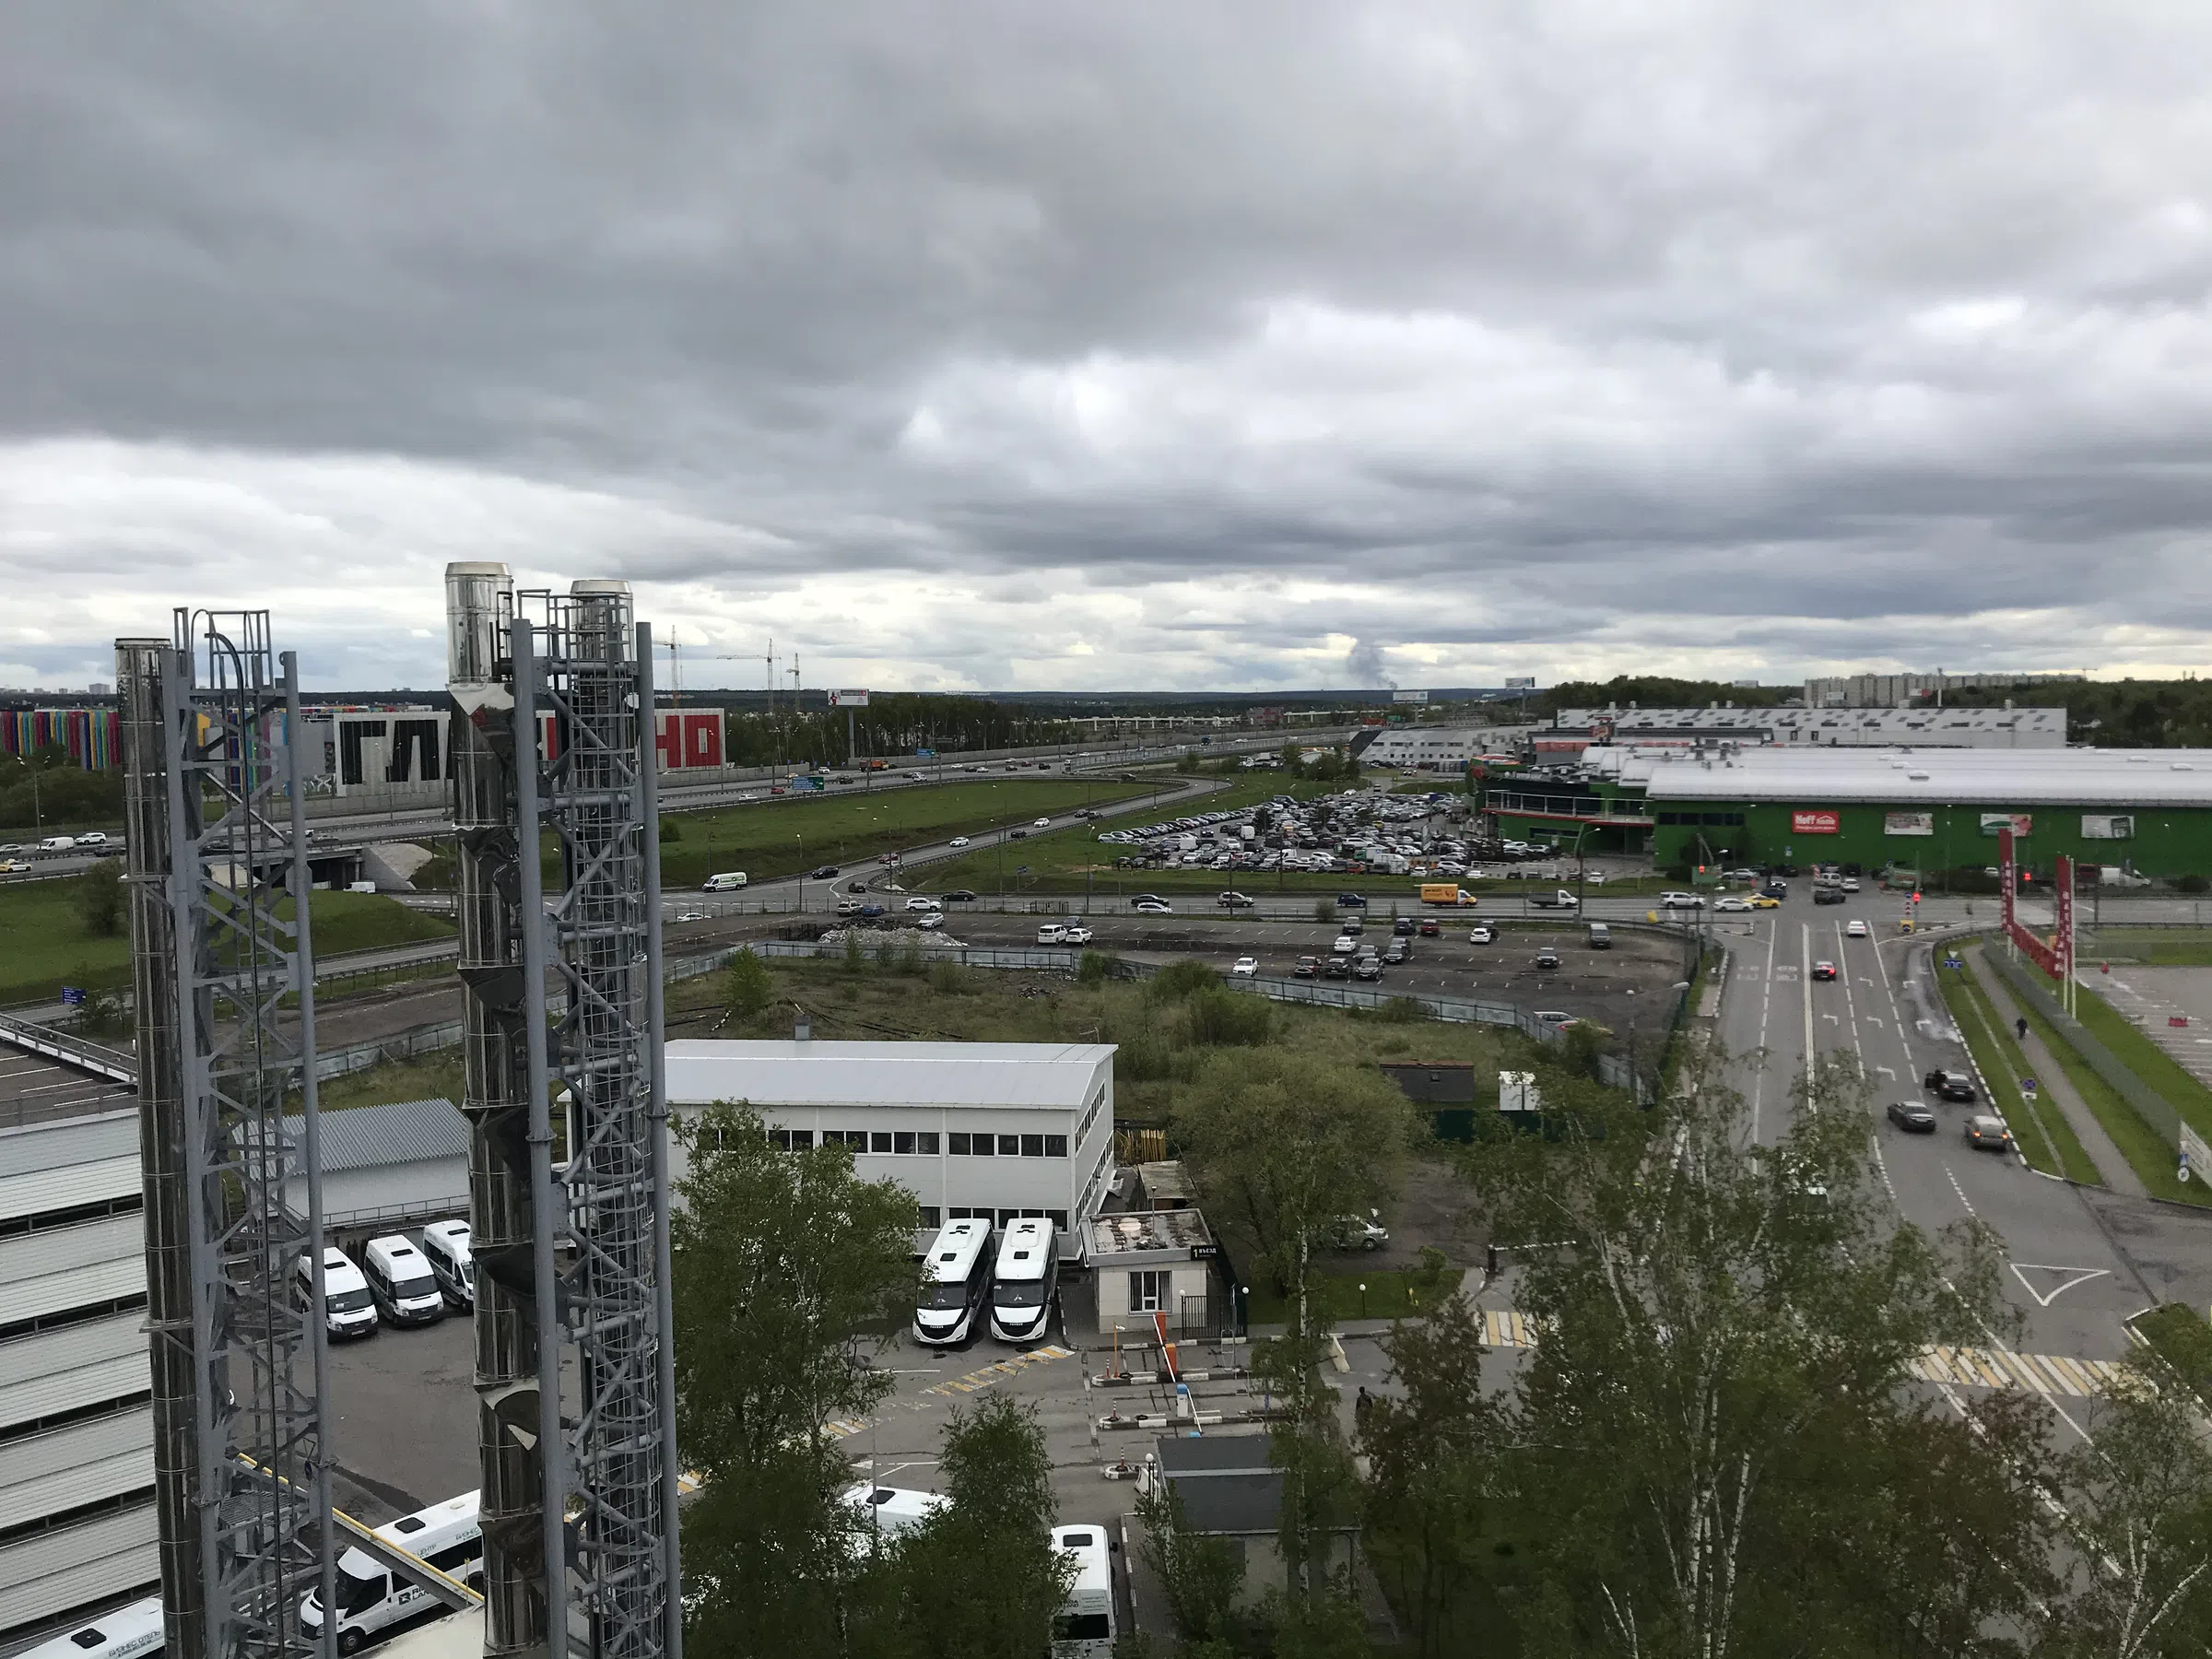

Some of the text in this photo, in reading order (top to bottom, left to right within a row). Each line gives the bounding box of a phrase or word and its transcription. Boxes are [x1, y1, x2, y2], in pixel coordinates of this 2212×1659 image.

[1193, 1248, 1198, 1258] 1
[417, 1544, 437, 1556] ЦЕНТР
[108, 1641, 137, 1657] БИЗНЕС
[137, 1630, 161, 1643] ОТЕЛЬ
